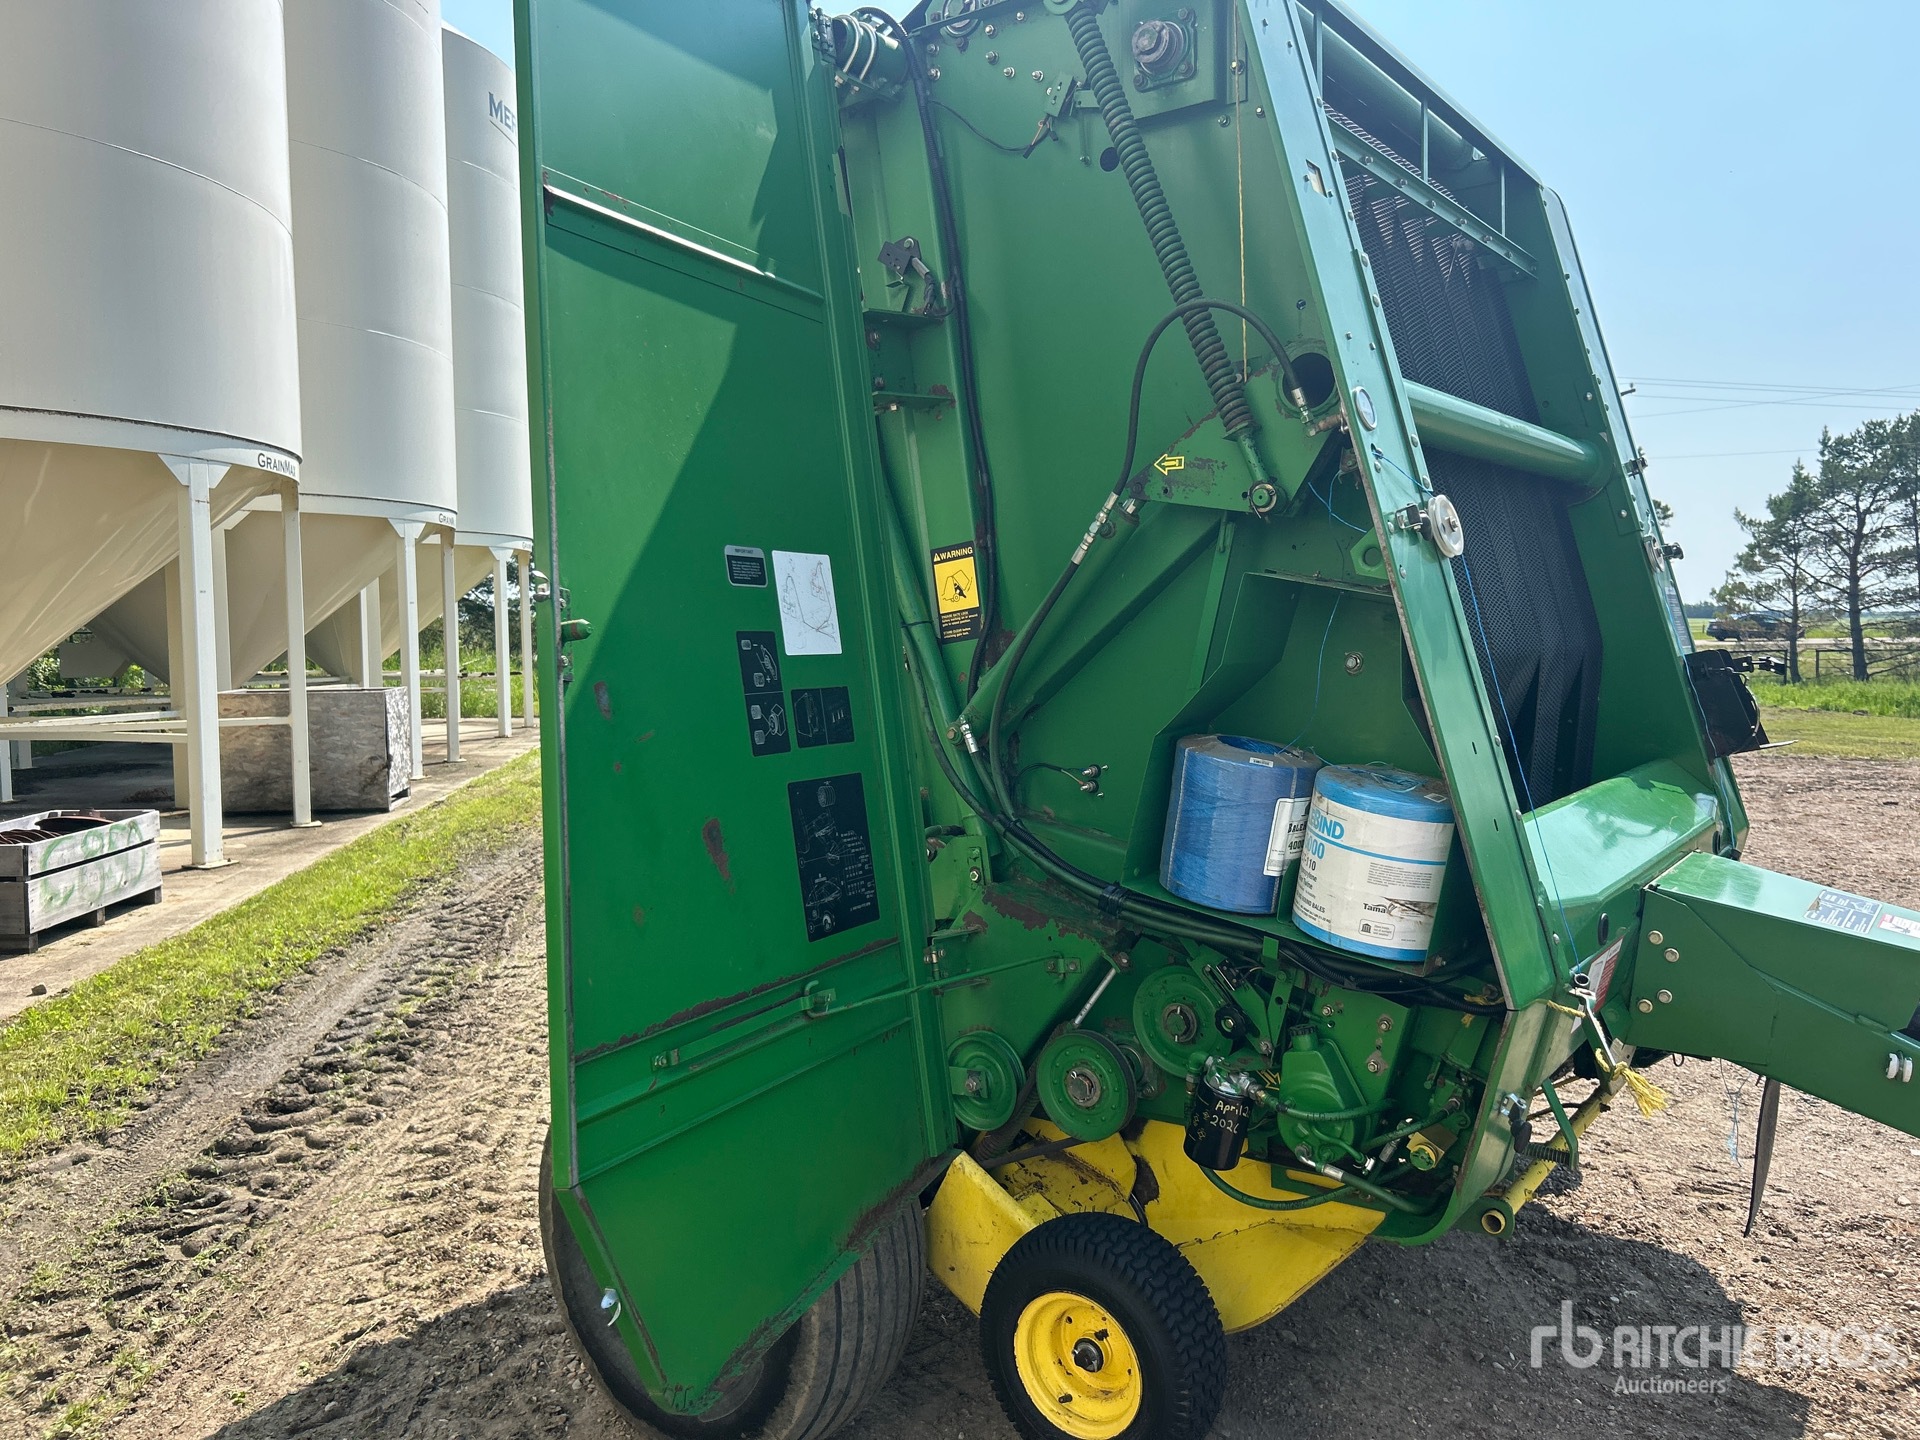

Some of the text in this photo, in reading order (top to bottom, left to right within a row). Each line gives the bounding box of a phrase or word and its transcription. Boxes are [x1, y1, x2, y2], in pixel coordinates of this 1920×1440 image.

[940, 546, 974, 560] WARNING
[1362, 902, 1387, 914] Tama
[1215, 1100, 1243, 1116] April
